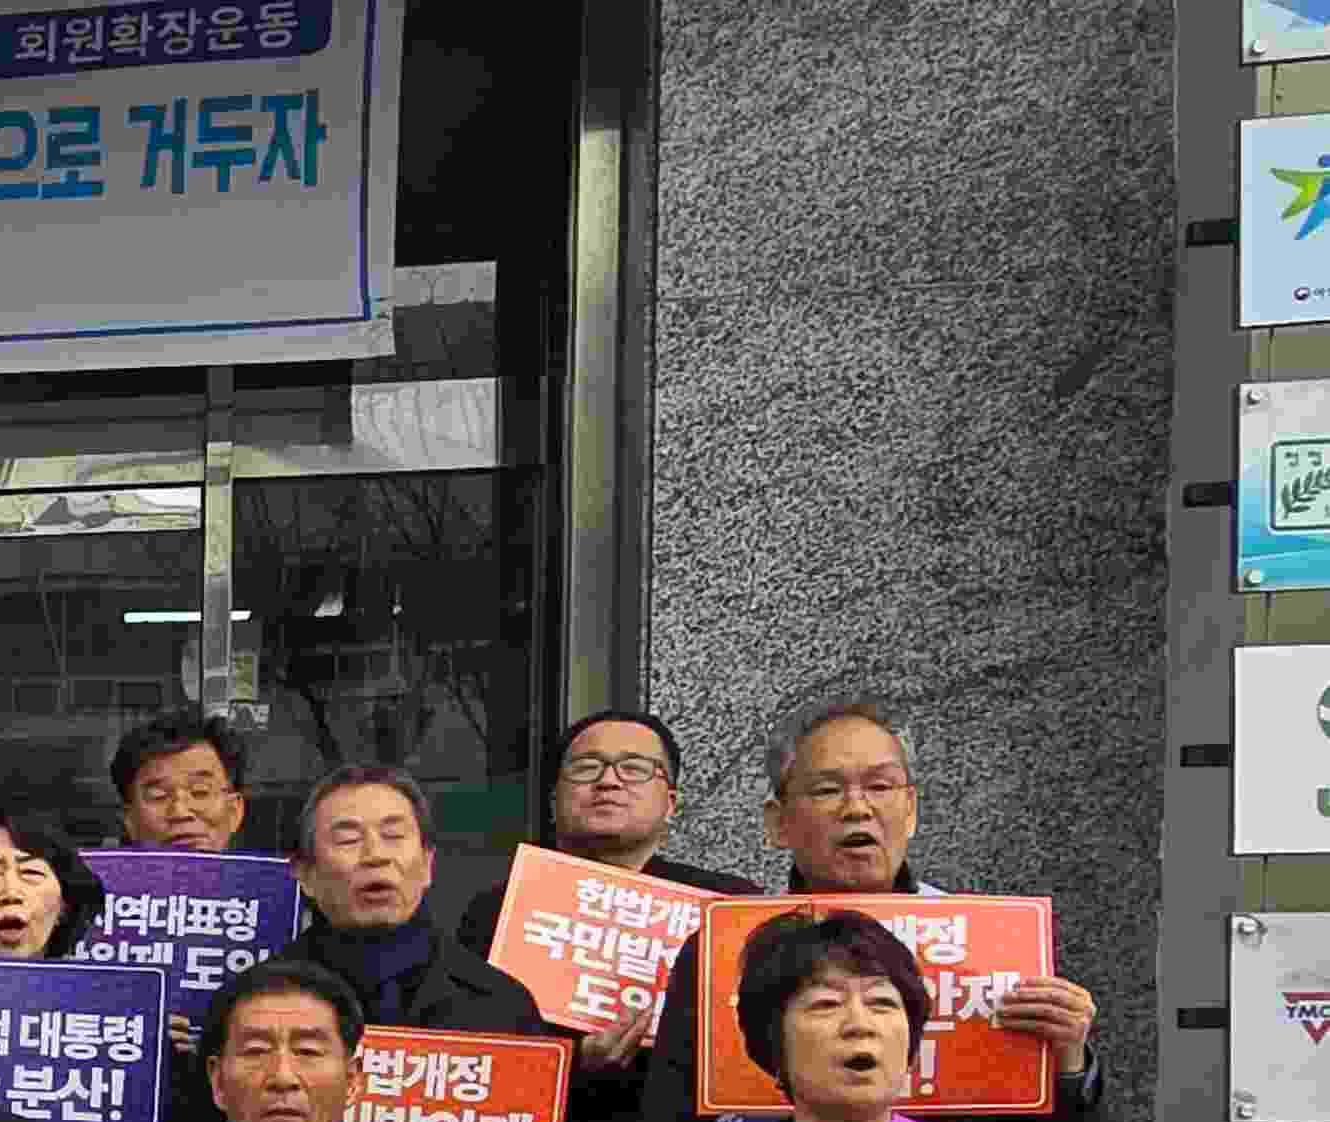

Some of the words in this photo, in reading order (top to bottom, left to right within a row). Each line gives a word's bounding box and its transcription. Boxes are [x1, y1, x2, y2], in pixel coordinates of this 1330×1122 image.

[15, 0, 300, 67] 회원확장운동
[126, 87, 328, 196] 거두자
[20, 1010, 144, 1063] 대통령
[6, 1063, 126, 1122] 분산!
[362, 1047, 493, 1103] 법개정
